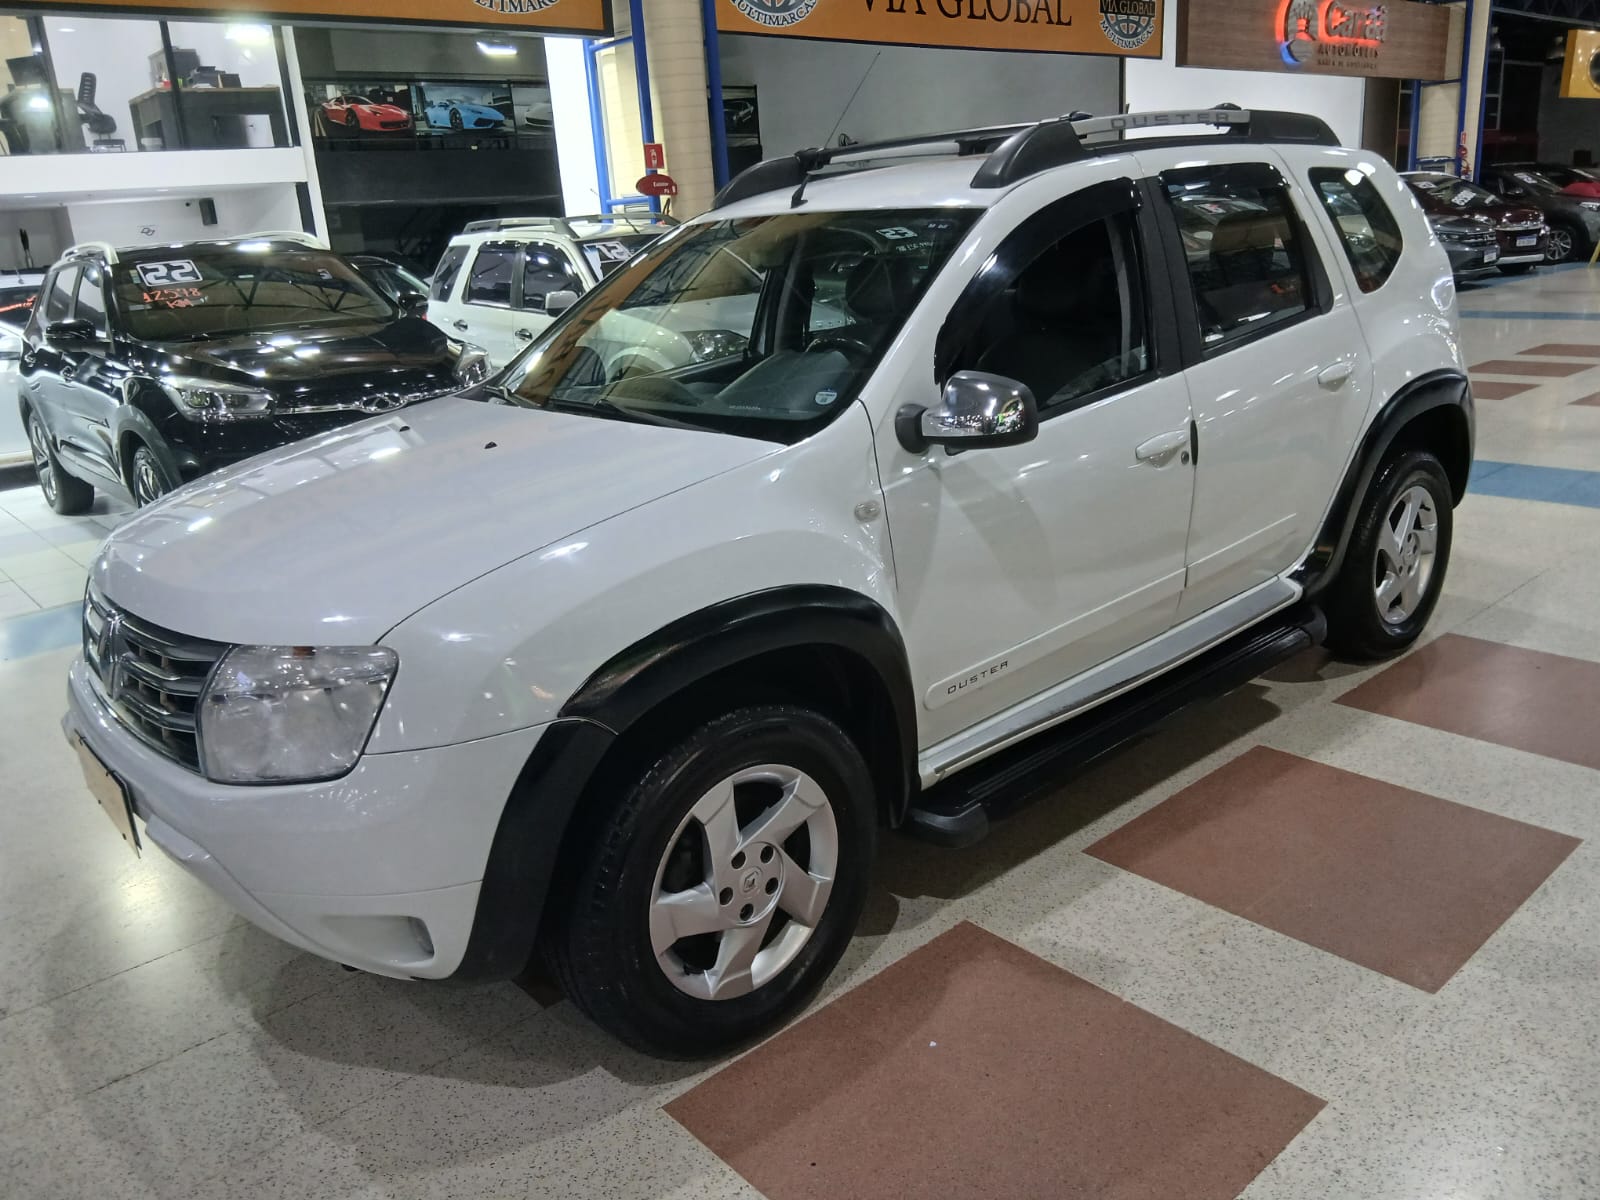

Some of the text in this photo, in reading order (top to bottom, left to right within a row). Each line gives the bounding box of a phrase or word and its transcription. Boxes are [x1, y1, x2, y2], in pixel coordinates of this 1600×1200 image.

[1119, 0, 1155, 16] GLOBAL
[1100, 20, 1154, 48] MULTIMARCAS
[1110, 113, 1229, 129] DUSTER
[143, 262, 197, 283] 22
[947, 660, 1009, 695] DUSTER
